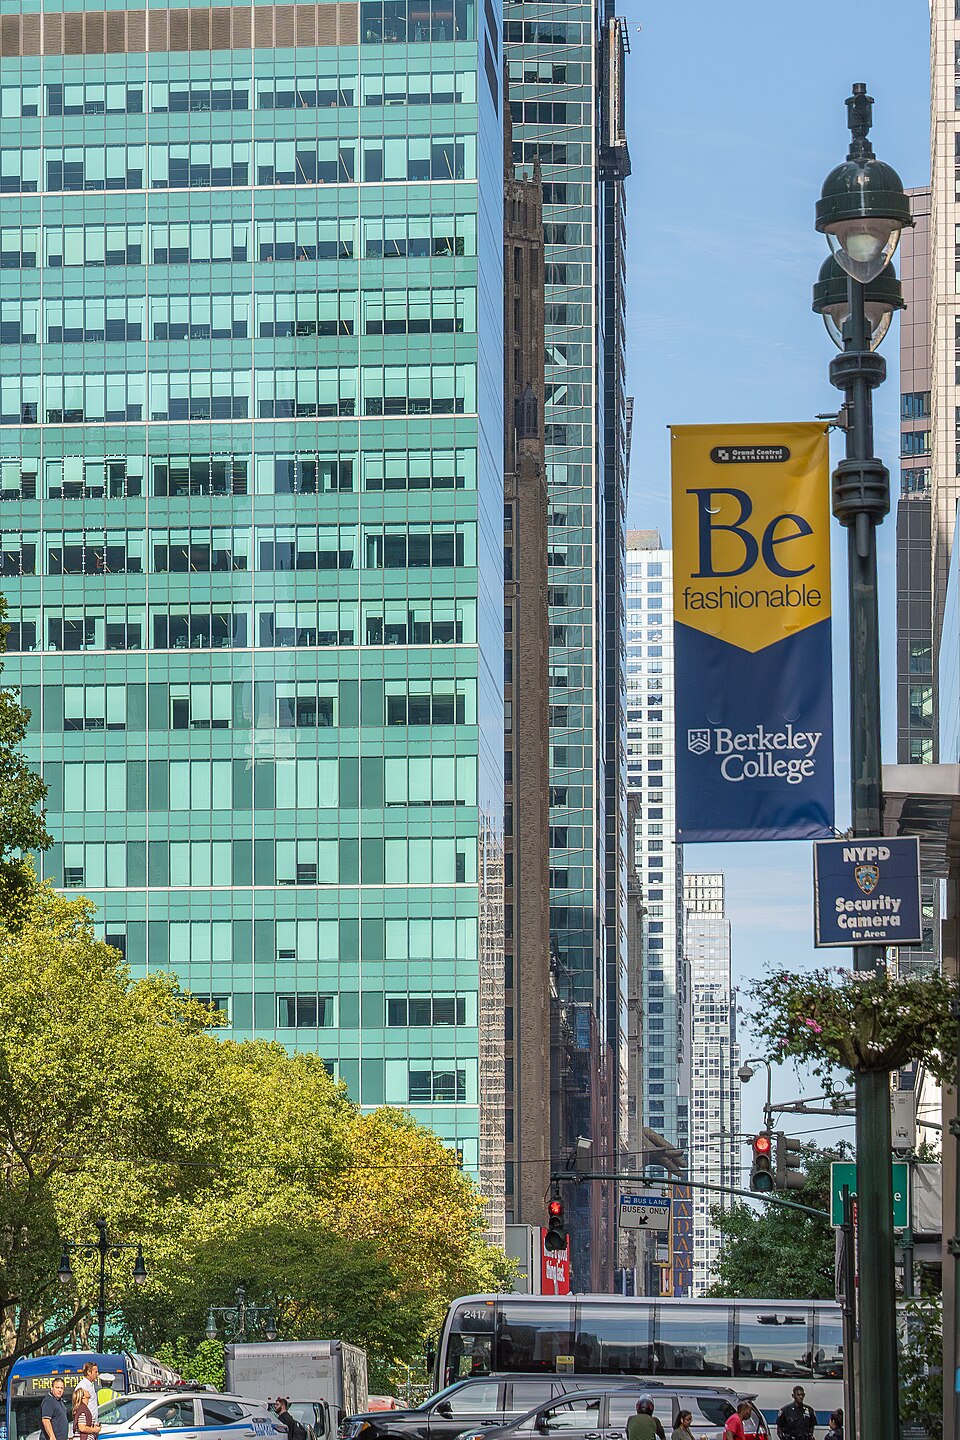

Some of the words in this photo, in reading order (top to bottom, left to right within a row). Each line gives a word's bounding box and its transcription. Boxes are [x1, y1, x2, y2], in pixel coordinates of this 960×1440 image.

[756, 448, 783, 456] Central
[686, 488, 815, 578] Be
[682, 584, 822, 611] fashionable
[714, 724, 822, 757] Berkeley
[721, 752, 815, 784] College
[843, 846, 890, 862] NYPD
[835, 895, 901, 913] Security
[837, 913, 900, 929] Camera
[863, 930, 886, 938] Area
[633, 1197, 647, 1205] BUS
[622, 1205, 646, 1214] BUSES
[649, 1207, 668, 1216] ONLY
[463, 1309, 487, 1319] 2417
